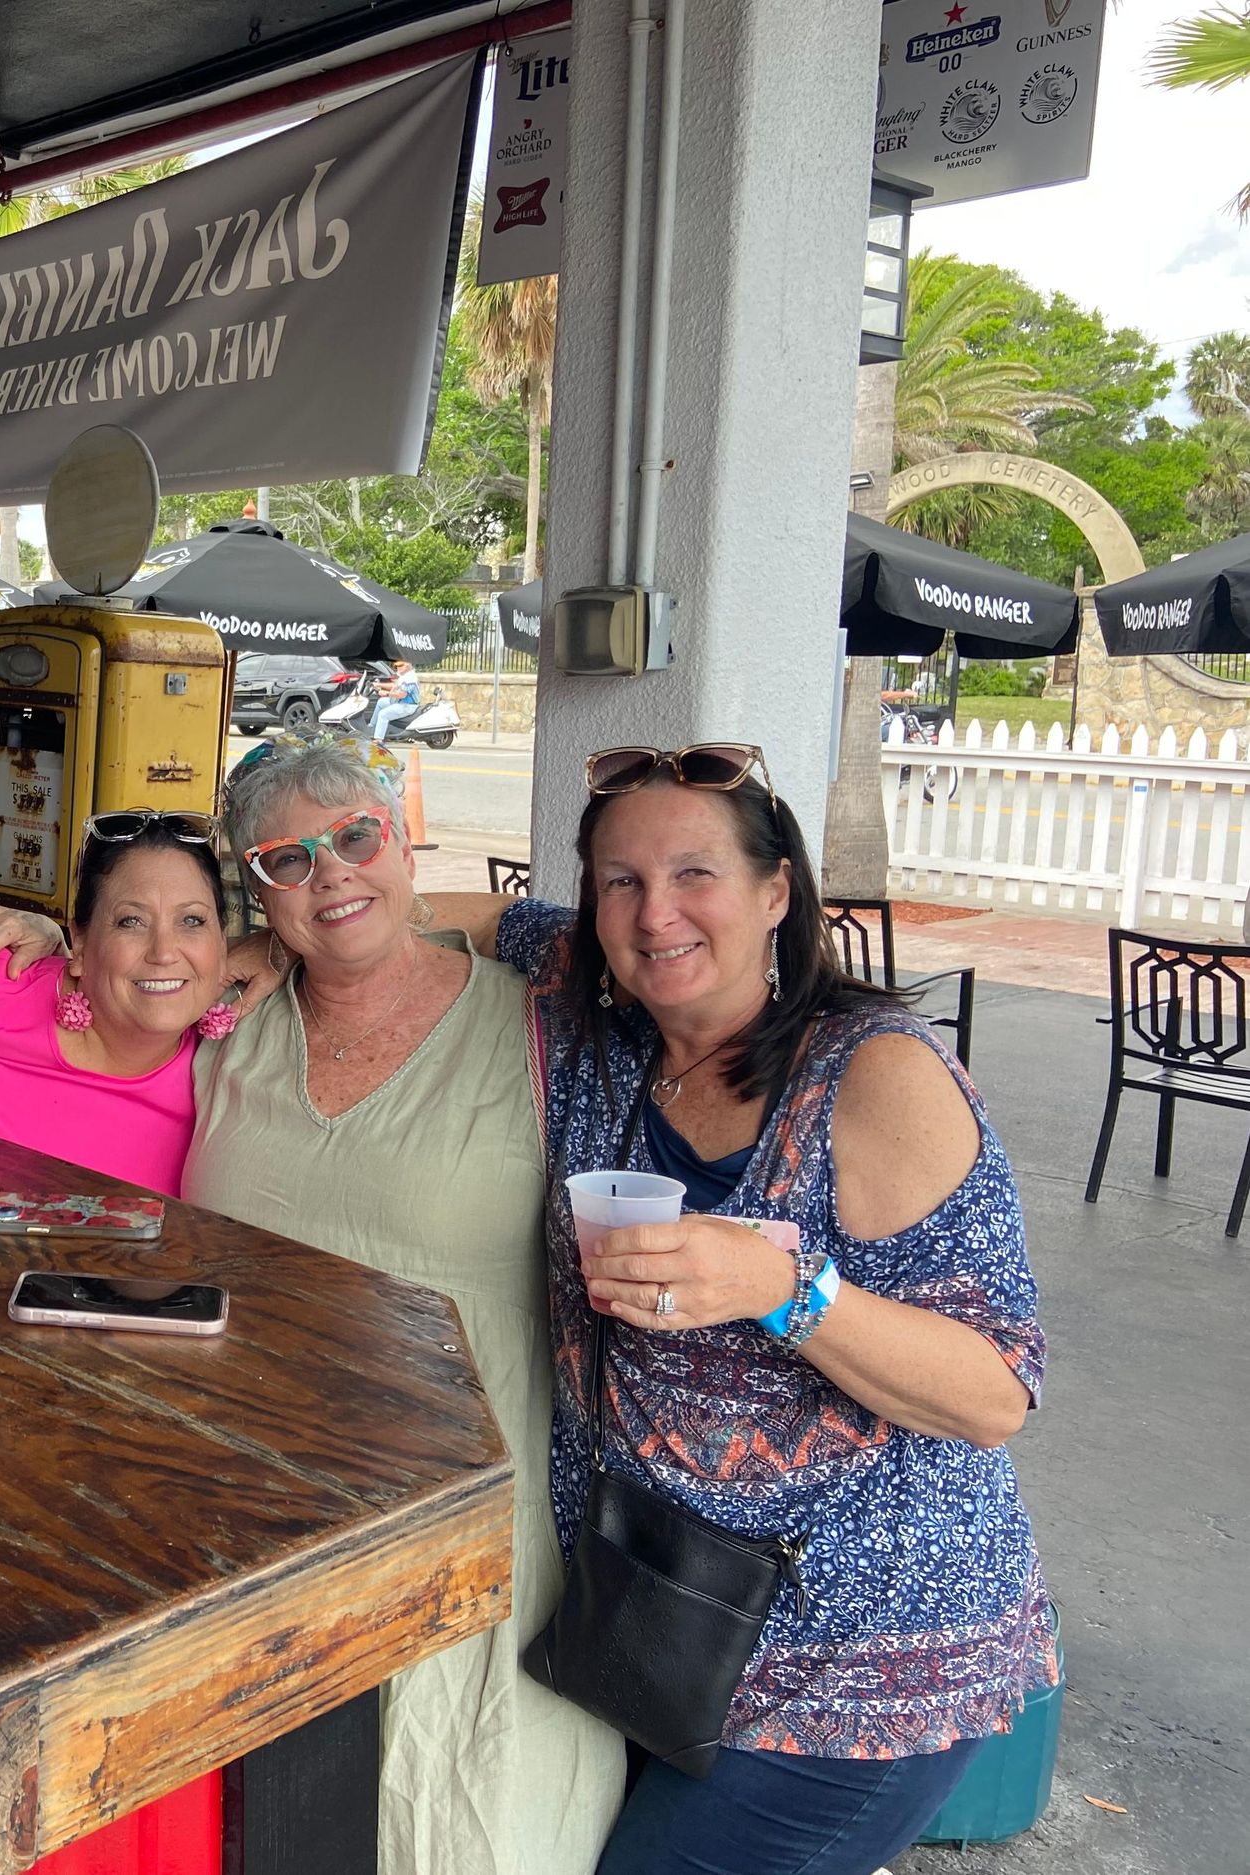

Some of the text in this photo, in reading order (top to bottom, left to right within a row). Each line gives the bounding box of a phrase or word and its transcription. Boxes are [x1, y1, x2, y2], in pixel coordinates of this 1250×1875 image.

[911, 22, 994, 57] Heineken
[1016, 24, 1092, 53] GUINNESS
[1019, 63, 1075, 108] WHITE CLAW
[939, 79, 998, 127] WHITE CLAW
[1036, 96, 1071, 121] SPIRITS
[877, 101, 926, 129] ngling
[948, 102, 997, 141] HARD SELTZER
[504, 128, 544, 146] ANGRY
[876, 127, 907, 139] TIONAL
[496, 138, 552, 160] ORCHARD
[874, 136, 908, 155] GER
[933, 143, 998, 163] BLACKCHERRY
[523, 153, 543, 164] CIDER
[946, 157, 982, 170] MANGO
[507, 189, 538, 211] Miller
[502, 208, 539, 223] HIGH LIFE
[891, 459, 1098, 519] WOOD CEMETERY
[914, 577, 1034, 625] VOODOO RANGER
[1122, 597, 1192, 631] VOODOO RANGER
[200, 611, 328, 642] VOODOO RANGER
[11, 782, 52, 798] THIS SALE
[13, 831, 43, 844] GALLONS
